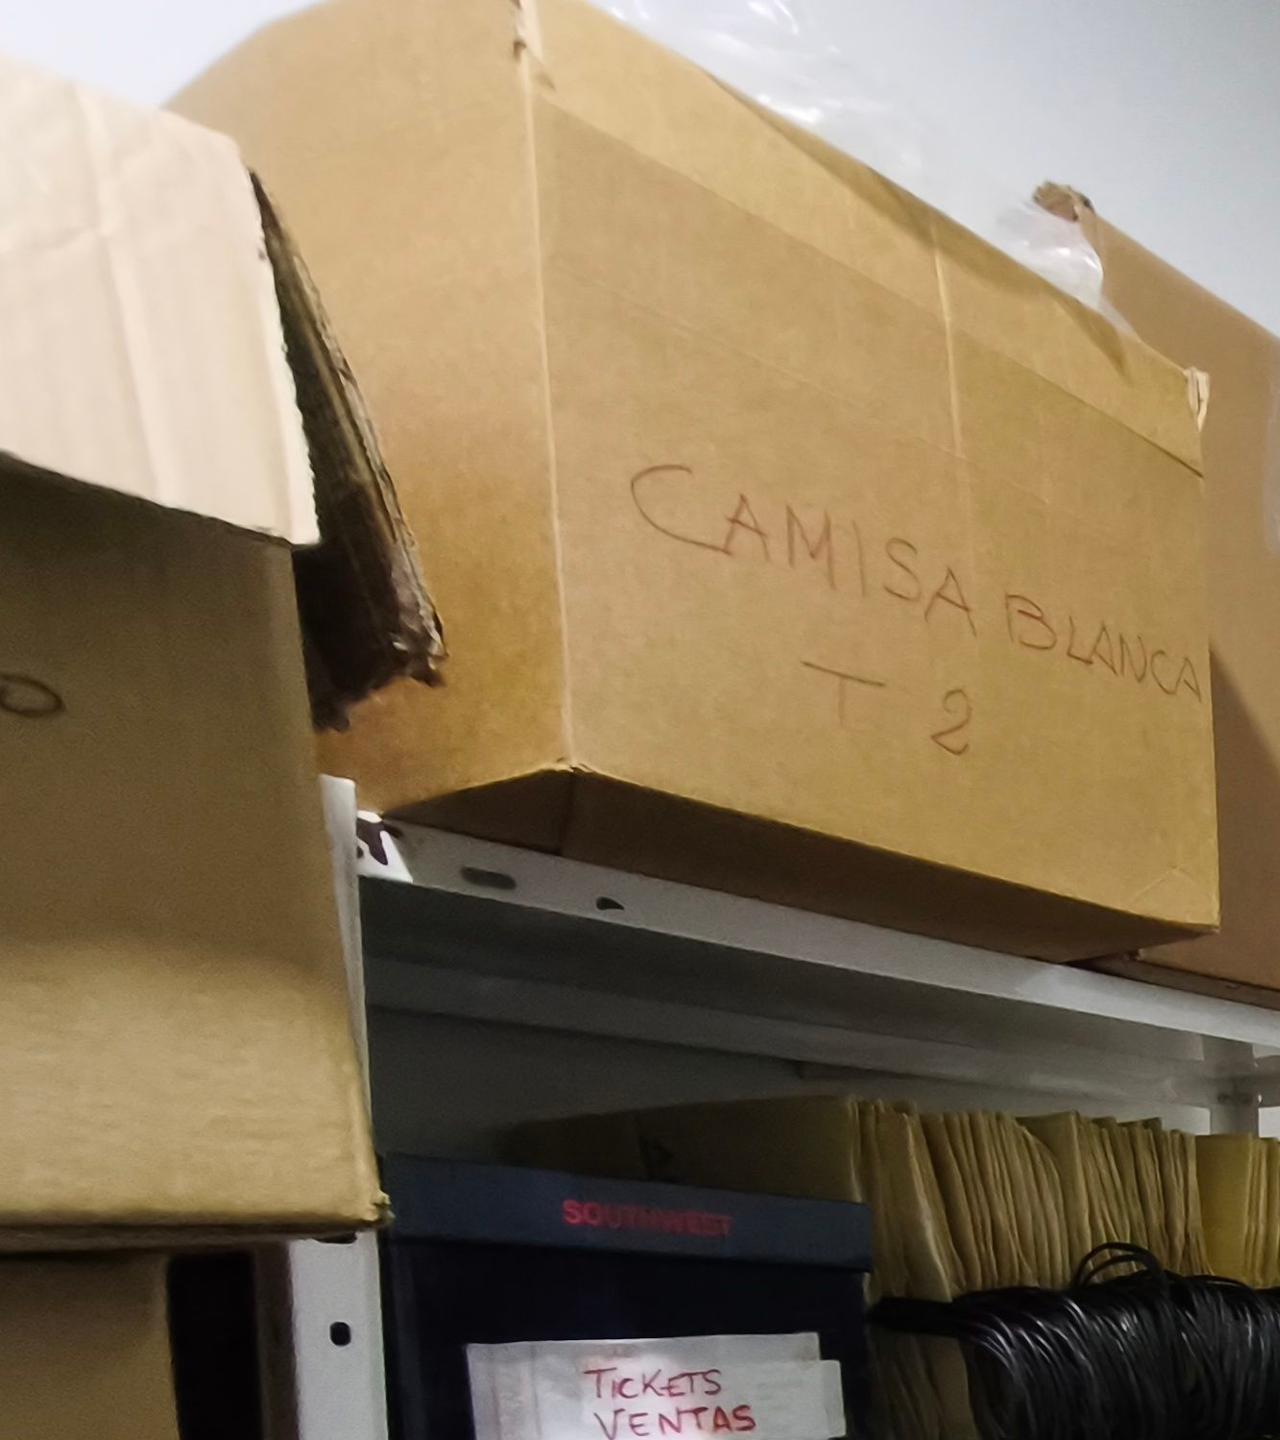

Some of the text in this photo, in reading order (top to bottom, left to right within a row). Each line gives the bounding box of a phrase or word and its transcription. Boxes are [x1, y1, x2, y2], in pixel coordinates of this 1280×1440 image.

[630, 464, 1202, 704] CAMISA BLANCA
[802, 661, 973, 755] T 2
[584, 1367, 722, 1400] TICKETS
[593, 1405, 756, 1440] VENTAS
